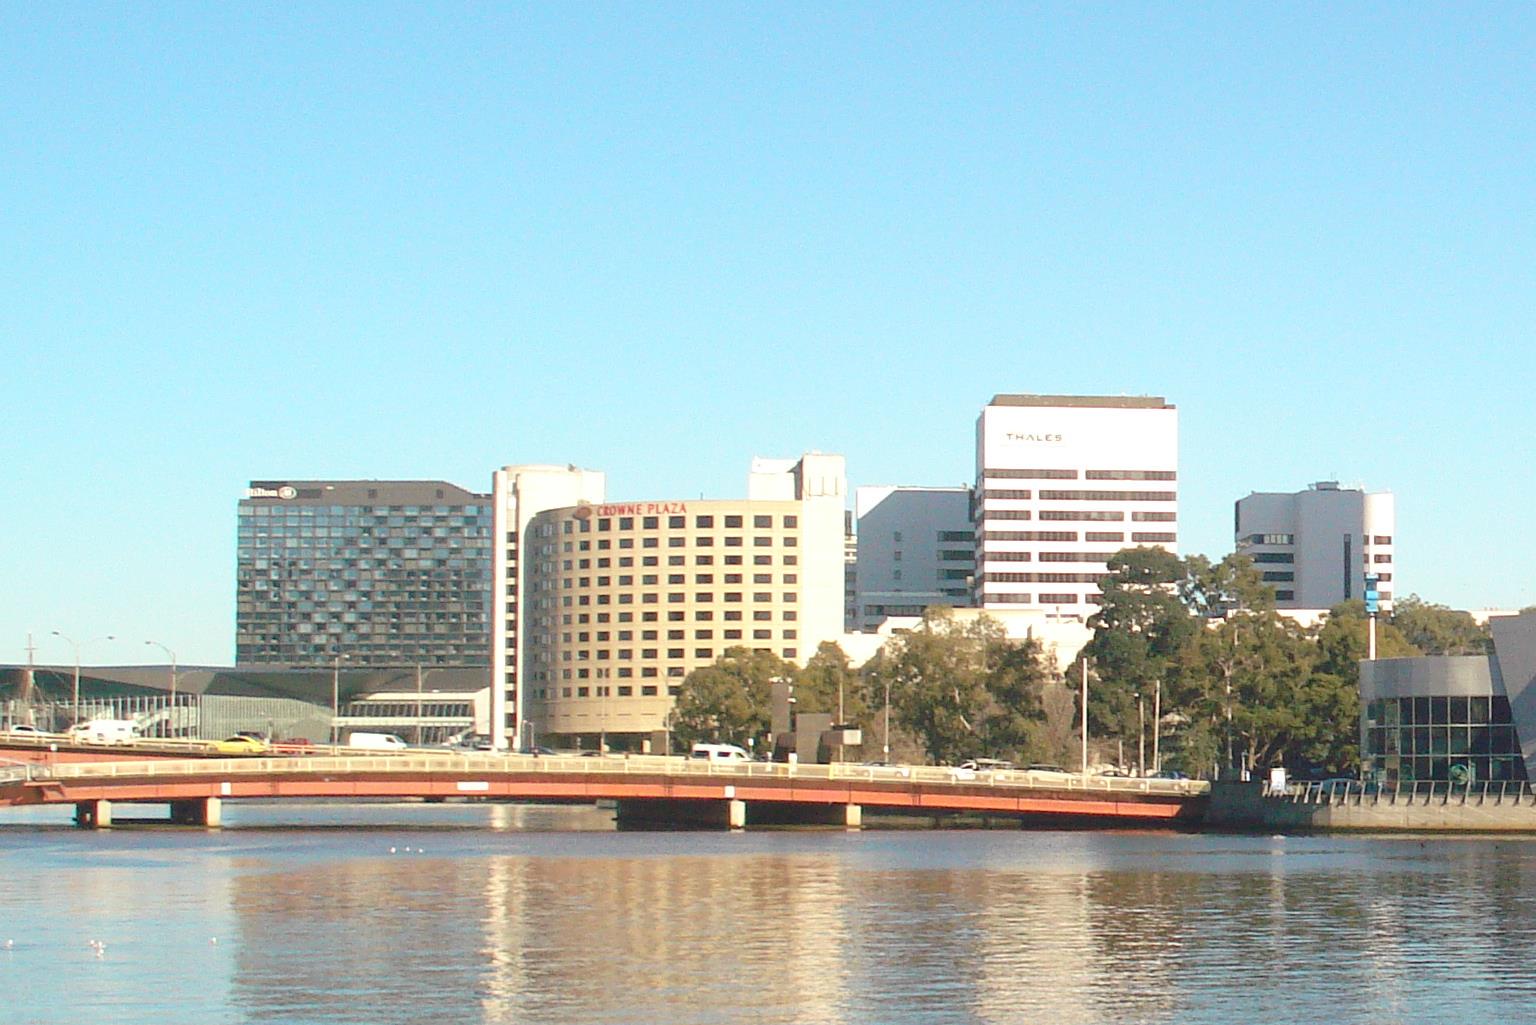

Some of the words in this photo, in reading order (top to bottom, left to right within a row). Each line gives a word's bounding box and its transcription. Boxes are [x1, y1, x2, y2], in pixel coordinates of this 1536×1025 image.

[1006, 433, 1062, 442] THALES
[597, 504, 642, 517] CROWNE
[647, 502, 687, 514] PLAZA
